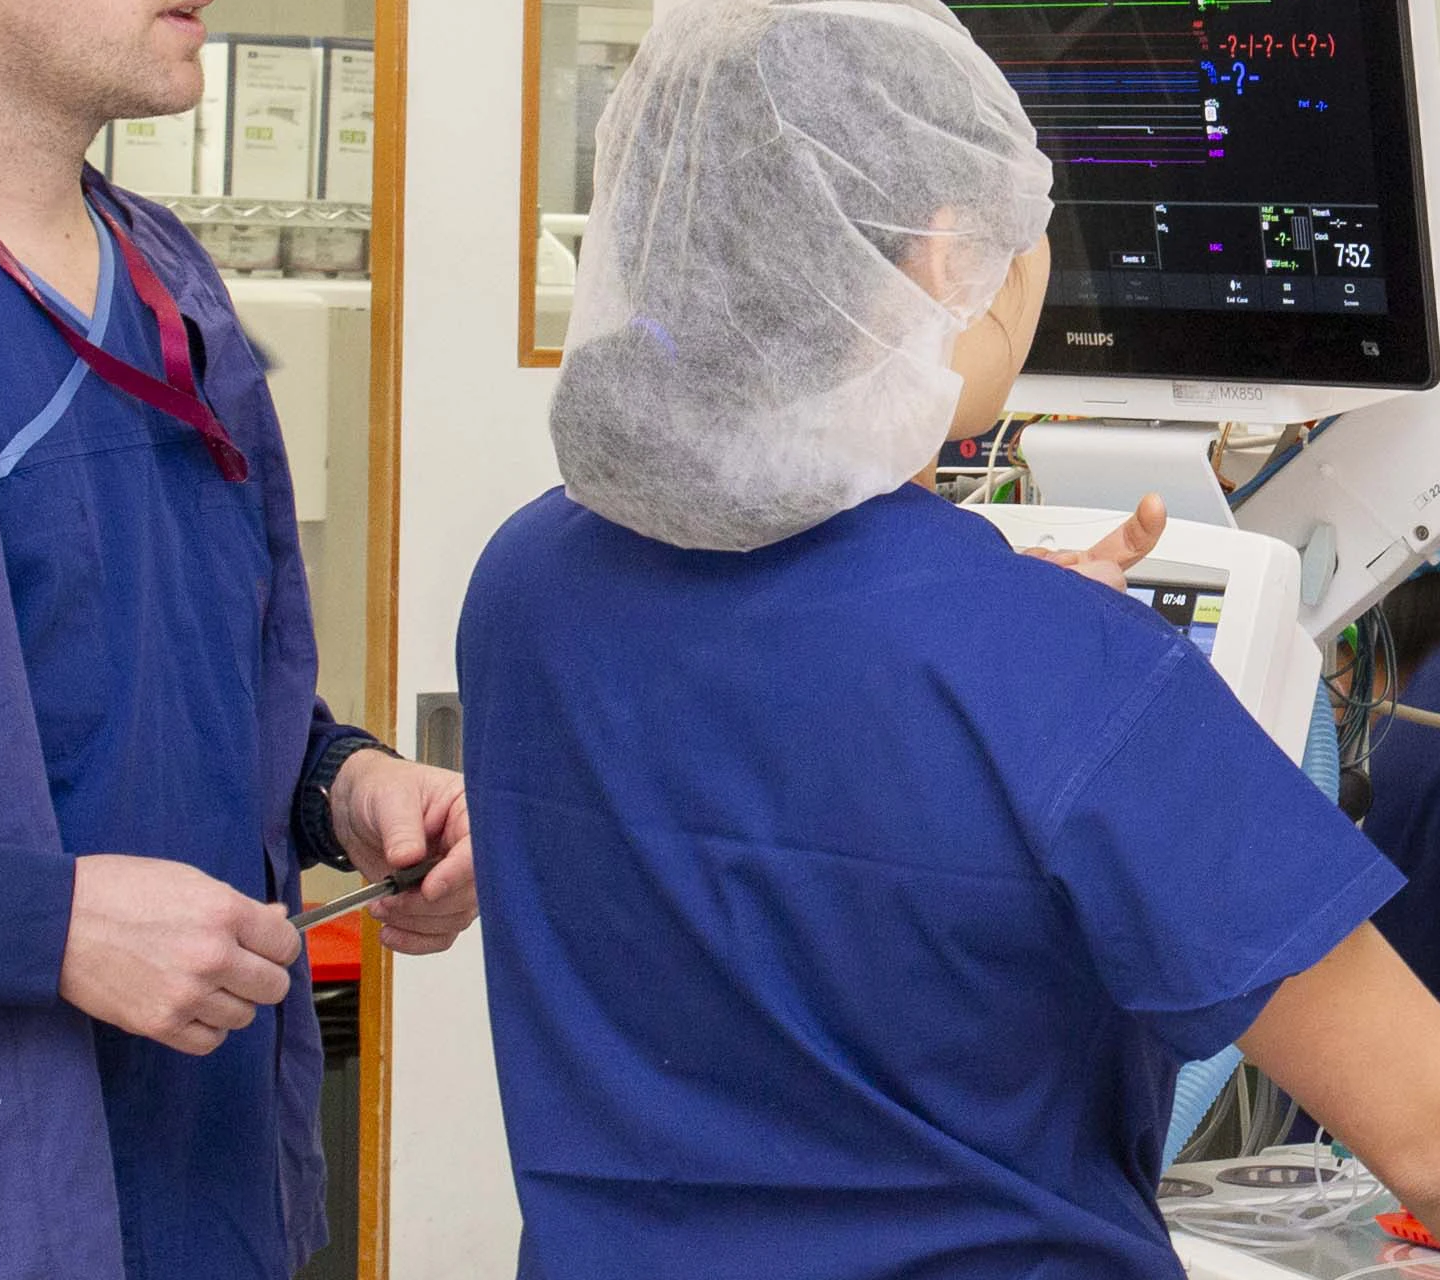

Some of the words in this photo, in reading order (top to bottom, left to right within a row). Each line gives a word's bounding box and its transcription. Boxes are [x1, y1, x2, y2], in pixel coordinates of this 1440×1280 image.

[1334, 243, 1371, 268] 7:52
[1066, 331, 1114, 347] PHILIPS
[1219, 386, 1264, 402] MX850
